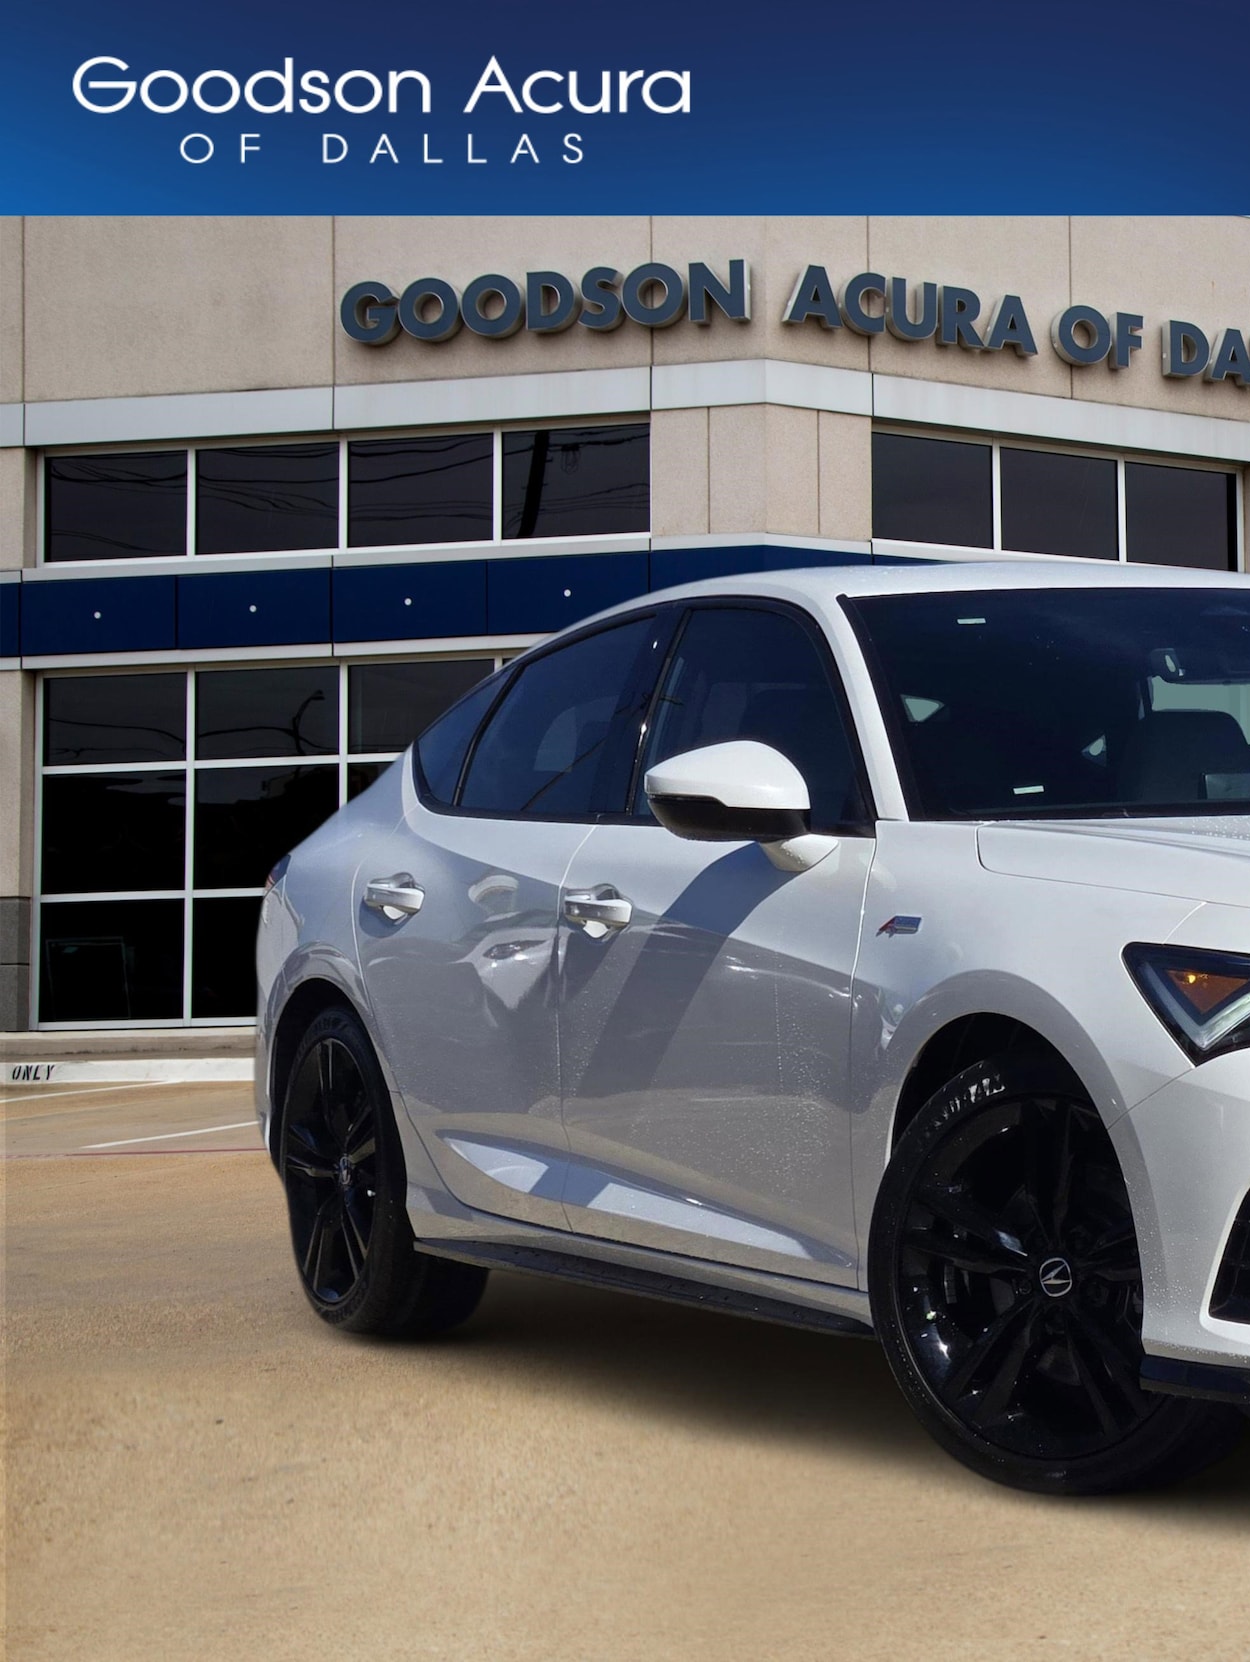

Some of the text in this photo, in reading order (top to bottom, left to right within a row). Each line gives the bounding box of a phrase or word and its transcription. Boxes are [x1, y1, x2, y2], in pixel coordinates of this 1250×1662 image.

[340, 258, 752, 346] GOODSON
[782, 264, 1038, 358] ACURA
[1051, 304, 1144, 370] OF
[12, 1064, 55, 1081] ONLY
